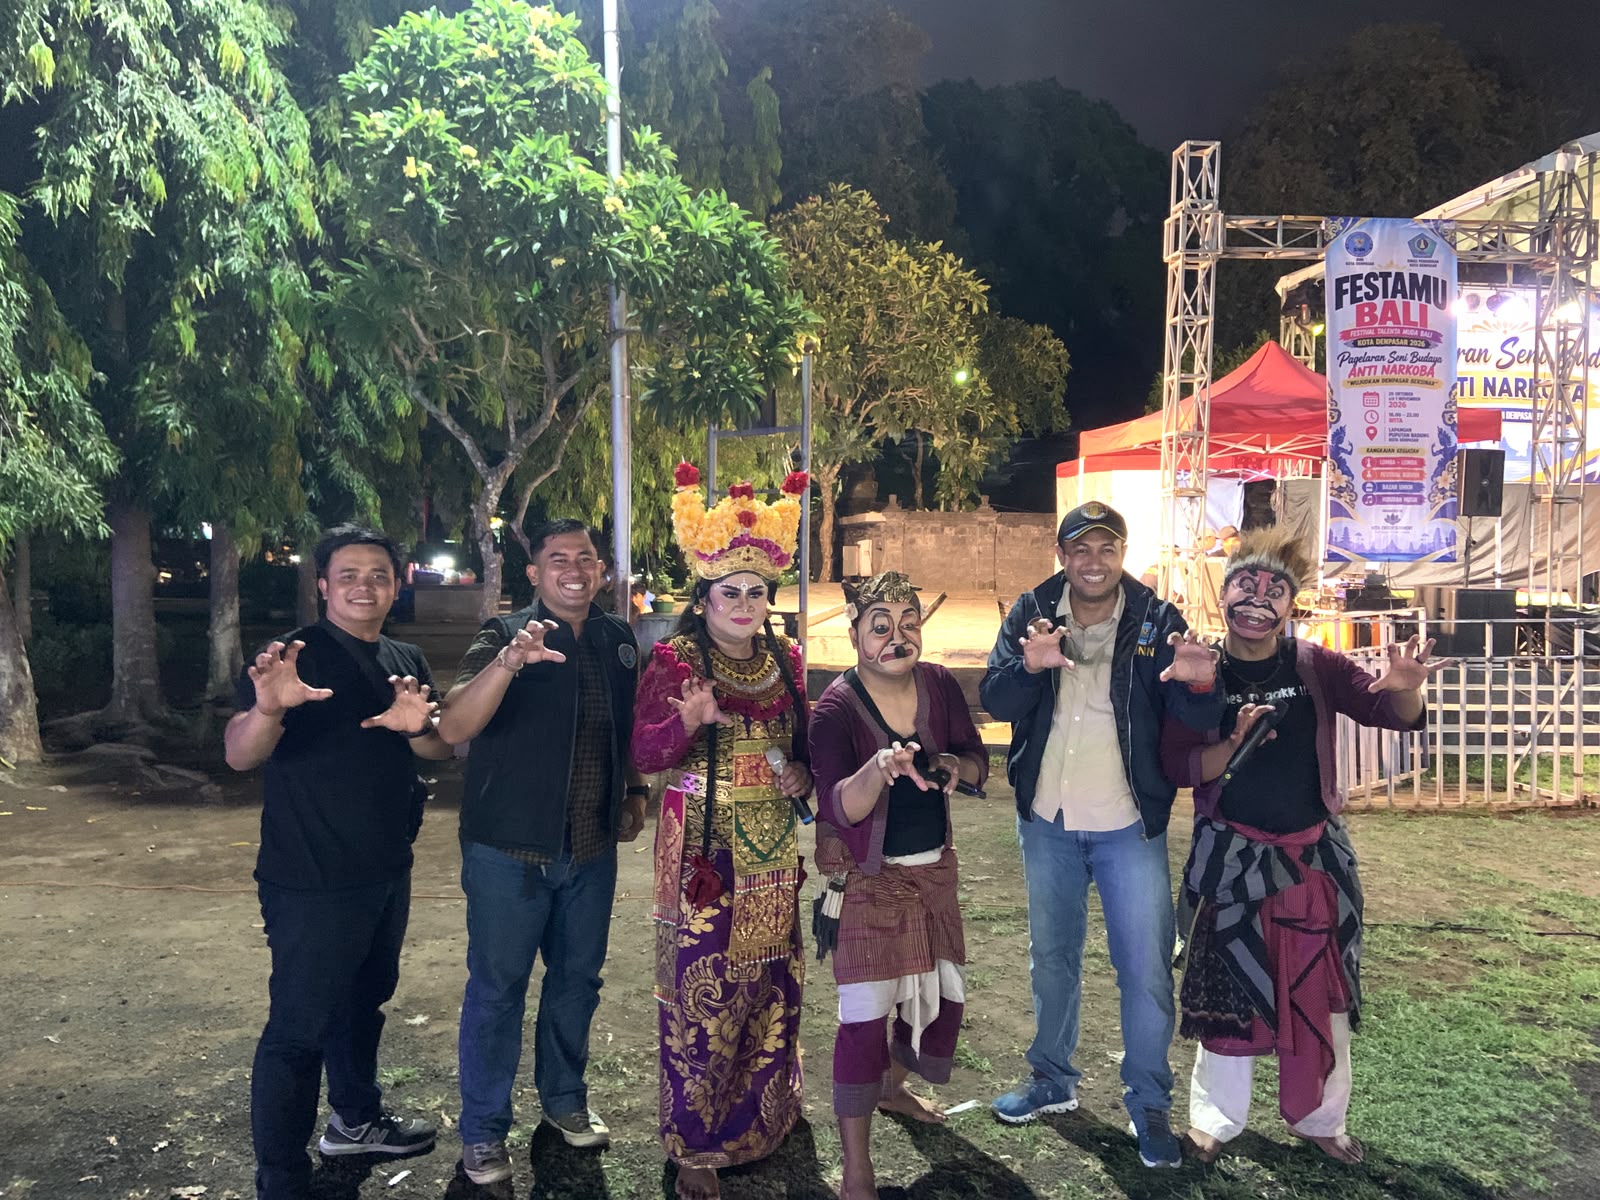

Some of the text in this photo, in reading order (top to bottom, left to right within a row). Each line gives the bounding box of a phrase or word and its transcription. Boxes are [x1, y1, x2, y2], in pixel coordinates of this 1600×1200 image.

[1335, 272, 1447, 311] FESTAMU
[1355, 300, 1428, 328] BALI
[1350, 329, 1375, 337] FESTIVAL
[1420, 330, 1433, 338] BALI
[1357, 338, 1374, 347] KOTA
[1376, 338, 1409, 346] DENPASAR
[1337, 351, 1443, 368] Pagelaran Seni Budaya
[1348, 364, 1435, 378] ANTI NARKOBA
[1136, 645, 1155, 657] NN
